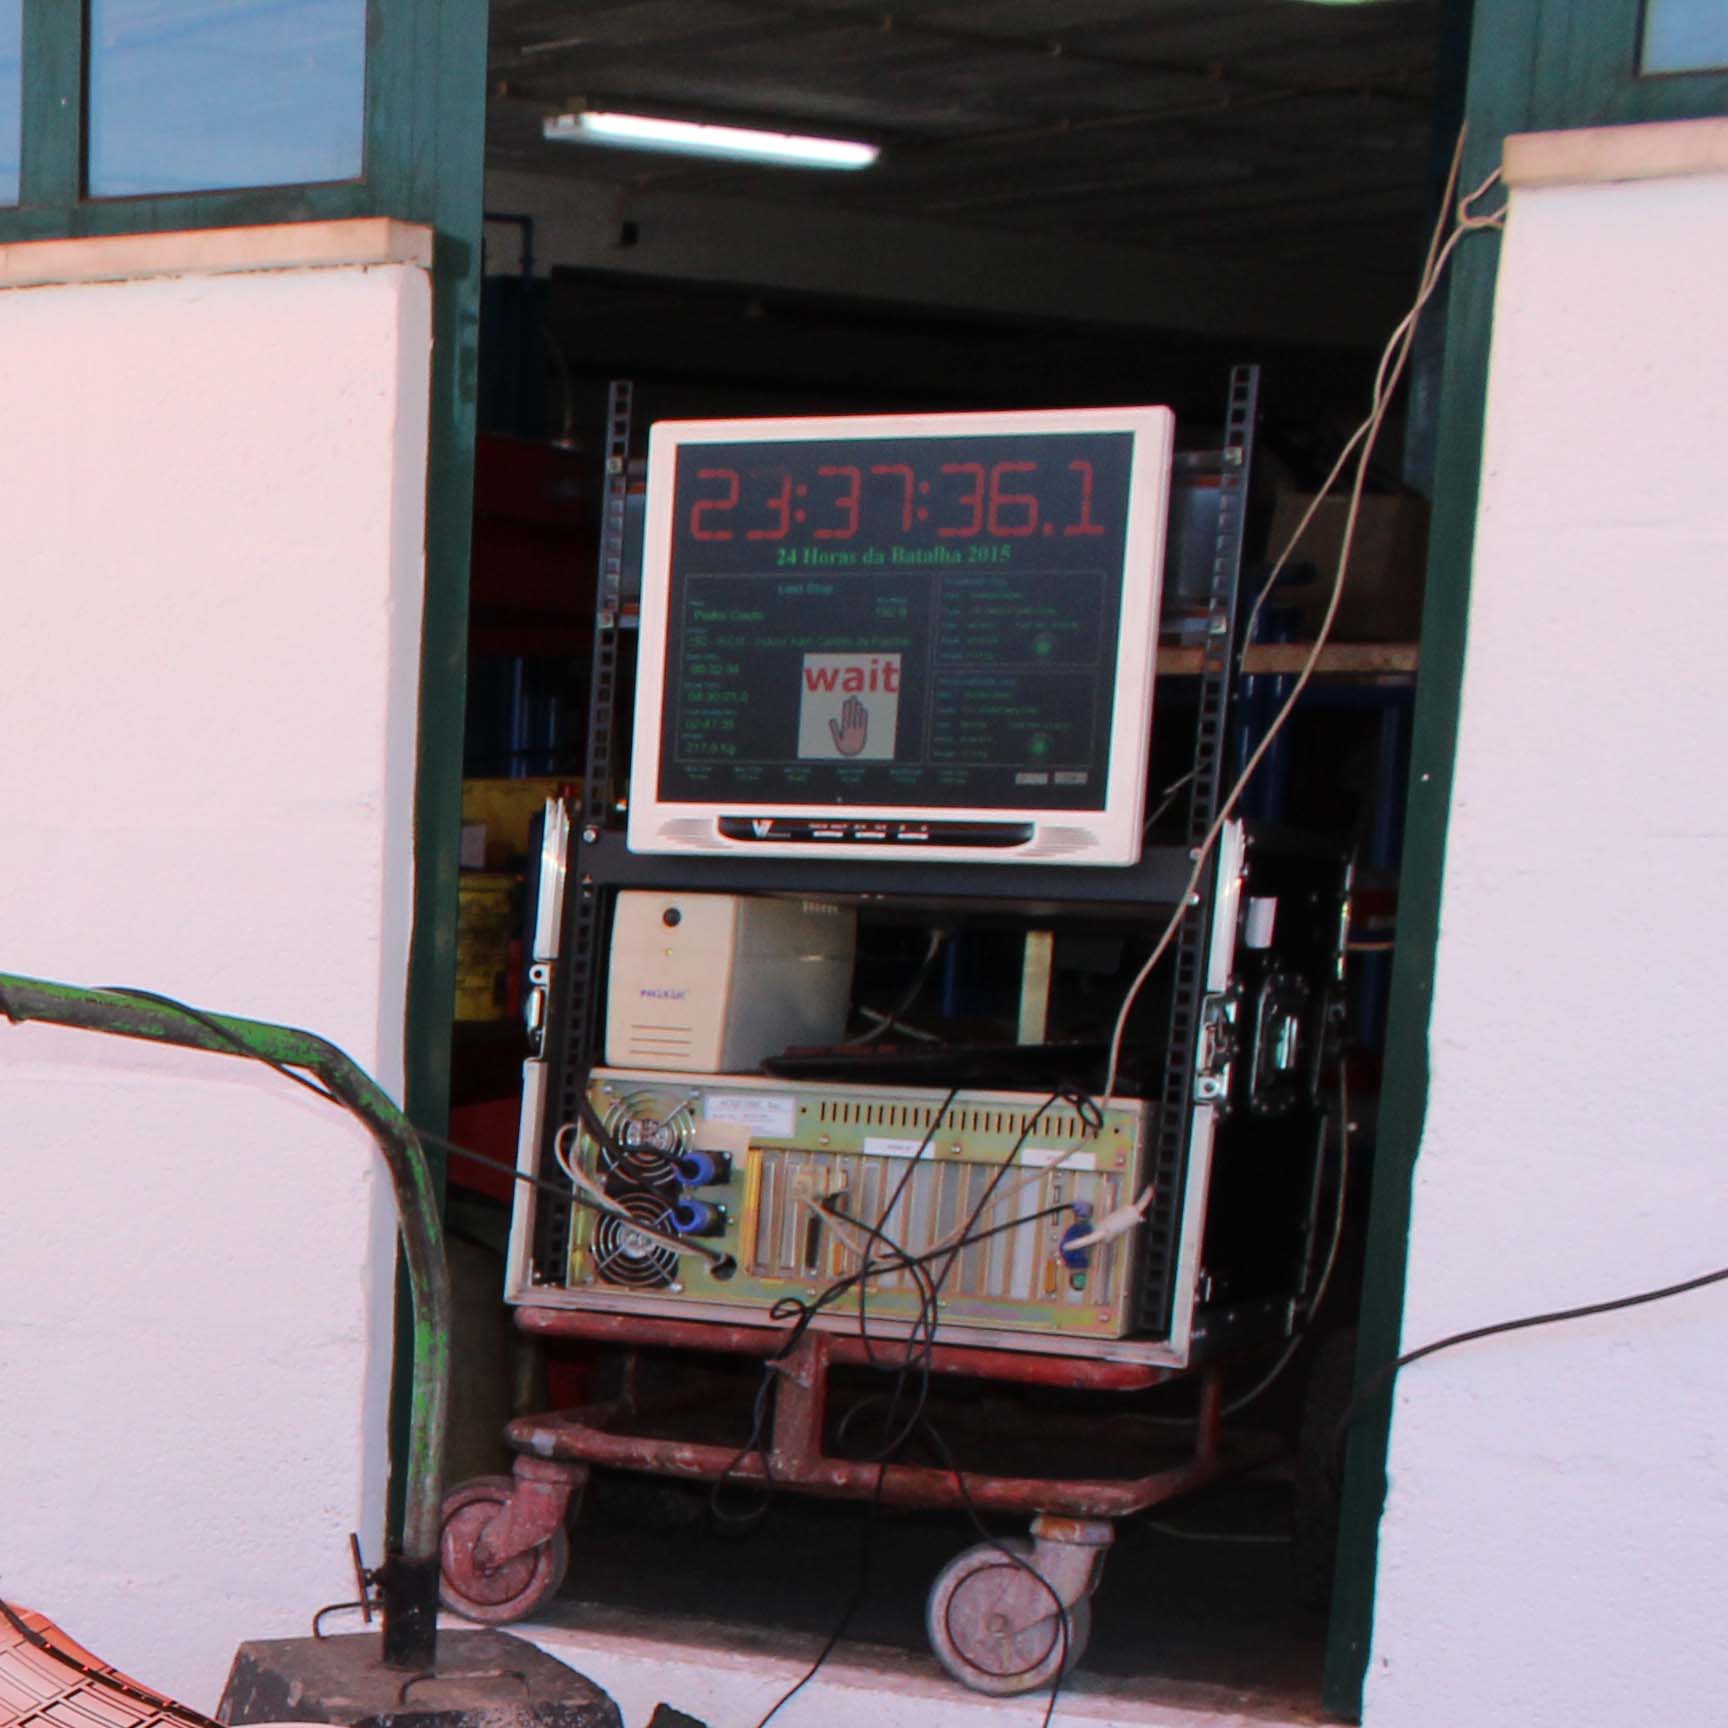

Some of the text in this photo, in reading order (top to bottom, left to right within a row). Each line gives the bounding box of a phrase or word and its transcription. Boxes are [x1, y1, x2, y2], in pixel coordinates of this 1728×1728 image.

[775, 543, 1013, 567] 24 Horas da Batalha 2015
[804, 658, 901, 693] wait
